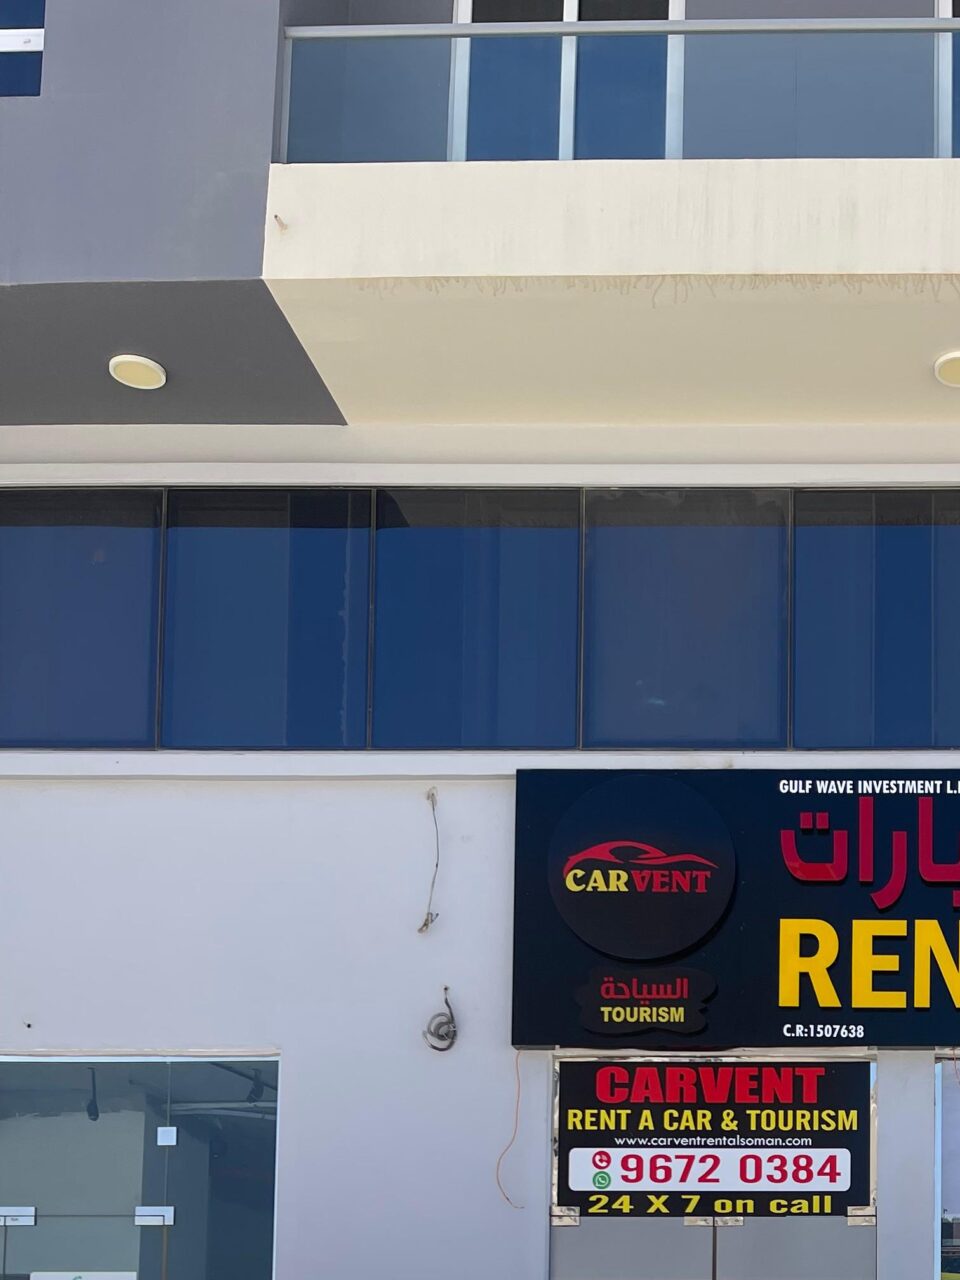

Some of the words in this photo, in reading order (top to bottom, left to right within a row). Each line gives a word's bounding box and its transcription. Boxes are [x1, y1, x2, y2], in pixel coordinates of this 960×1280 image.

[779, 779, 813, 795] GULF
[815, 779, 854, 795] WAVE
[857, 779, 943, 795] INVESTMENT
[565, 868, 711, 893] CARVENT
[600, 977, 689, 1004] السياحة
[600, 1006, 685, 1023] TOURISM
[782, 1023, 865, 1038] C.R:1507638
[595, 1065, 826, 1104] CARVENT
[567, 1109, 631, 1131] RENT
[638, 1109, 655, 1131] A
[663, 1109, 712, 1131] CAR
[720, 1109, 738, 1131] &
[745, 1109, 858, 1131] TOURISM
[614, 1134, 812, 1147] www.carventrentalsoman.com
[620, 1154, 721, 1184] 9672
[738, 1154, 842, 1184] 0384
[587, 1195, 634, 1214] 24
[646, 1195, 670, 1214] X
[681, 1195, 701, 1214] 7
[713, 1199, 755, 1214] on
[769, 1194, 832, 1214] call
